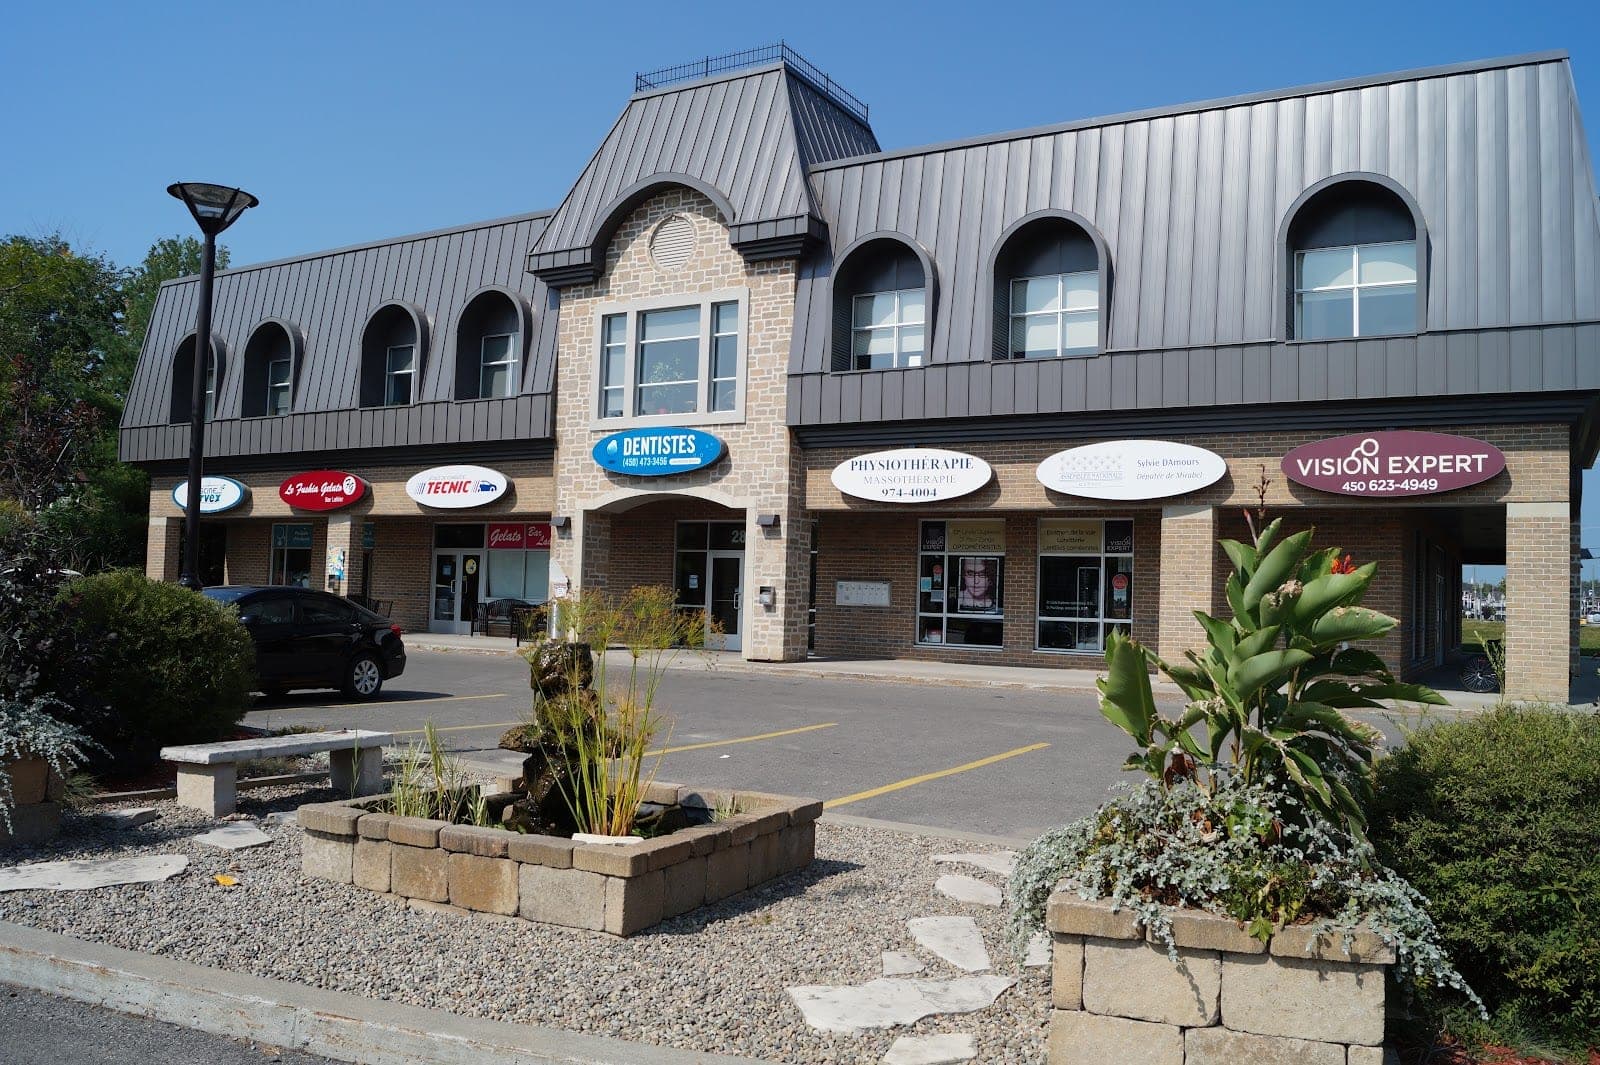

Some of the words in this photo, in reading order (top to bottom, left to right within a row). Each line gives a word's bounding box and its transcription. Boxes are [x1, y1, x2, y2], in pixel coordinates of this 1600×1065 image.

[623, 435, 696, 456] DENTISTES
[622, 458, 639, 468] (450)
[850, 456, 974, 471] PHYSIOTHÉRAPIE
[1137, 459, 1160, 468] Sylvie
[1296, 456, 1379, 477] VISION
[1388, 454, 1489, 474] EXPERT
[427, 480, 472, 494] TECNIC
[1342, 480, 1366, 492] 450
[1368, 478, 1438, 491] 623-4949
[881, 488, 938, 497] 974-4004
[490, 528, 521, 546] Gelato
[528, 526, 542, 537] Bar
